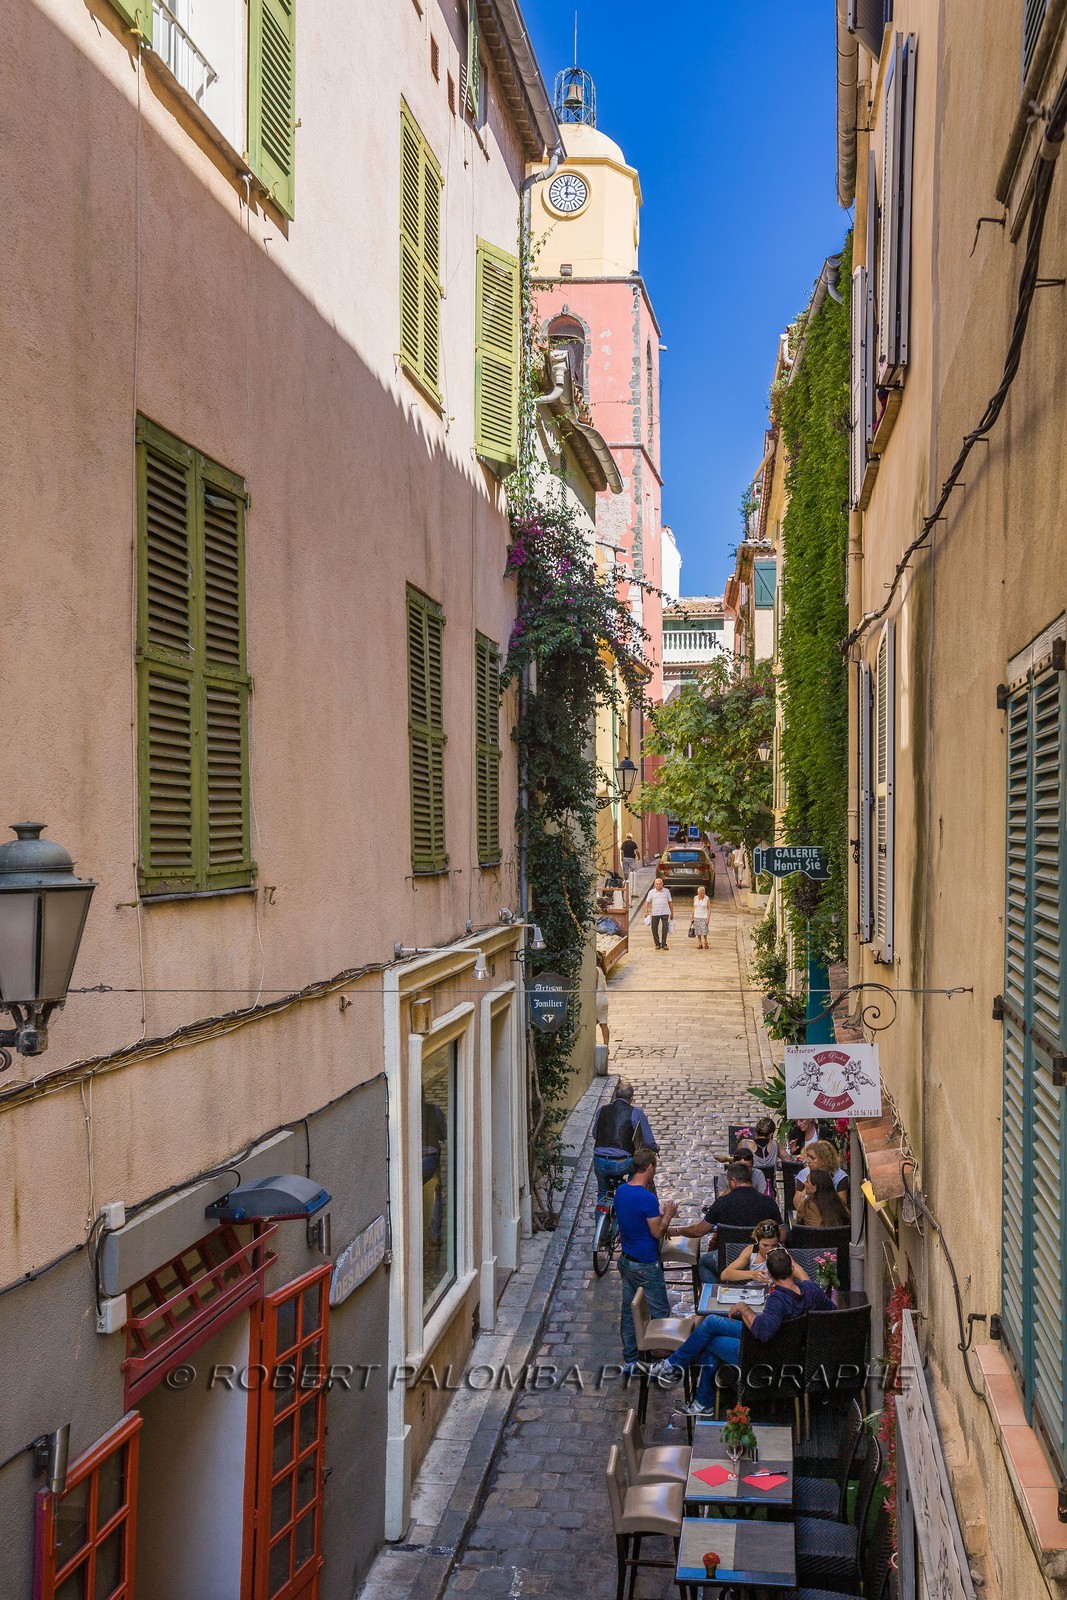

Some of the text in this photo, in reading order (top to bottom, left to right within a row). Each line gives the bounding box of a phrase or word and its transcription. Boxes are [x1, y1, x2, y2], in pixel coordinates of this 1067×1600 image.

[775, 848, 819, 858] GALERIE
[773, 858, 821, 871] Henri Sié
[534, 983, 563, 992] Artisan
[533, 998, 563, 1009] Joaillier
[786, 1046, 816, 1054] Restaurant
[817, 1095, 850, 1110] Mignon
[349, 1242, 361, 1265] LA
[335, 1242, 385, 1302] DES ANGES
